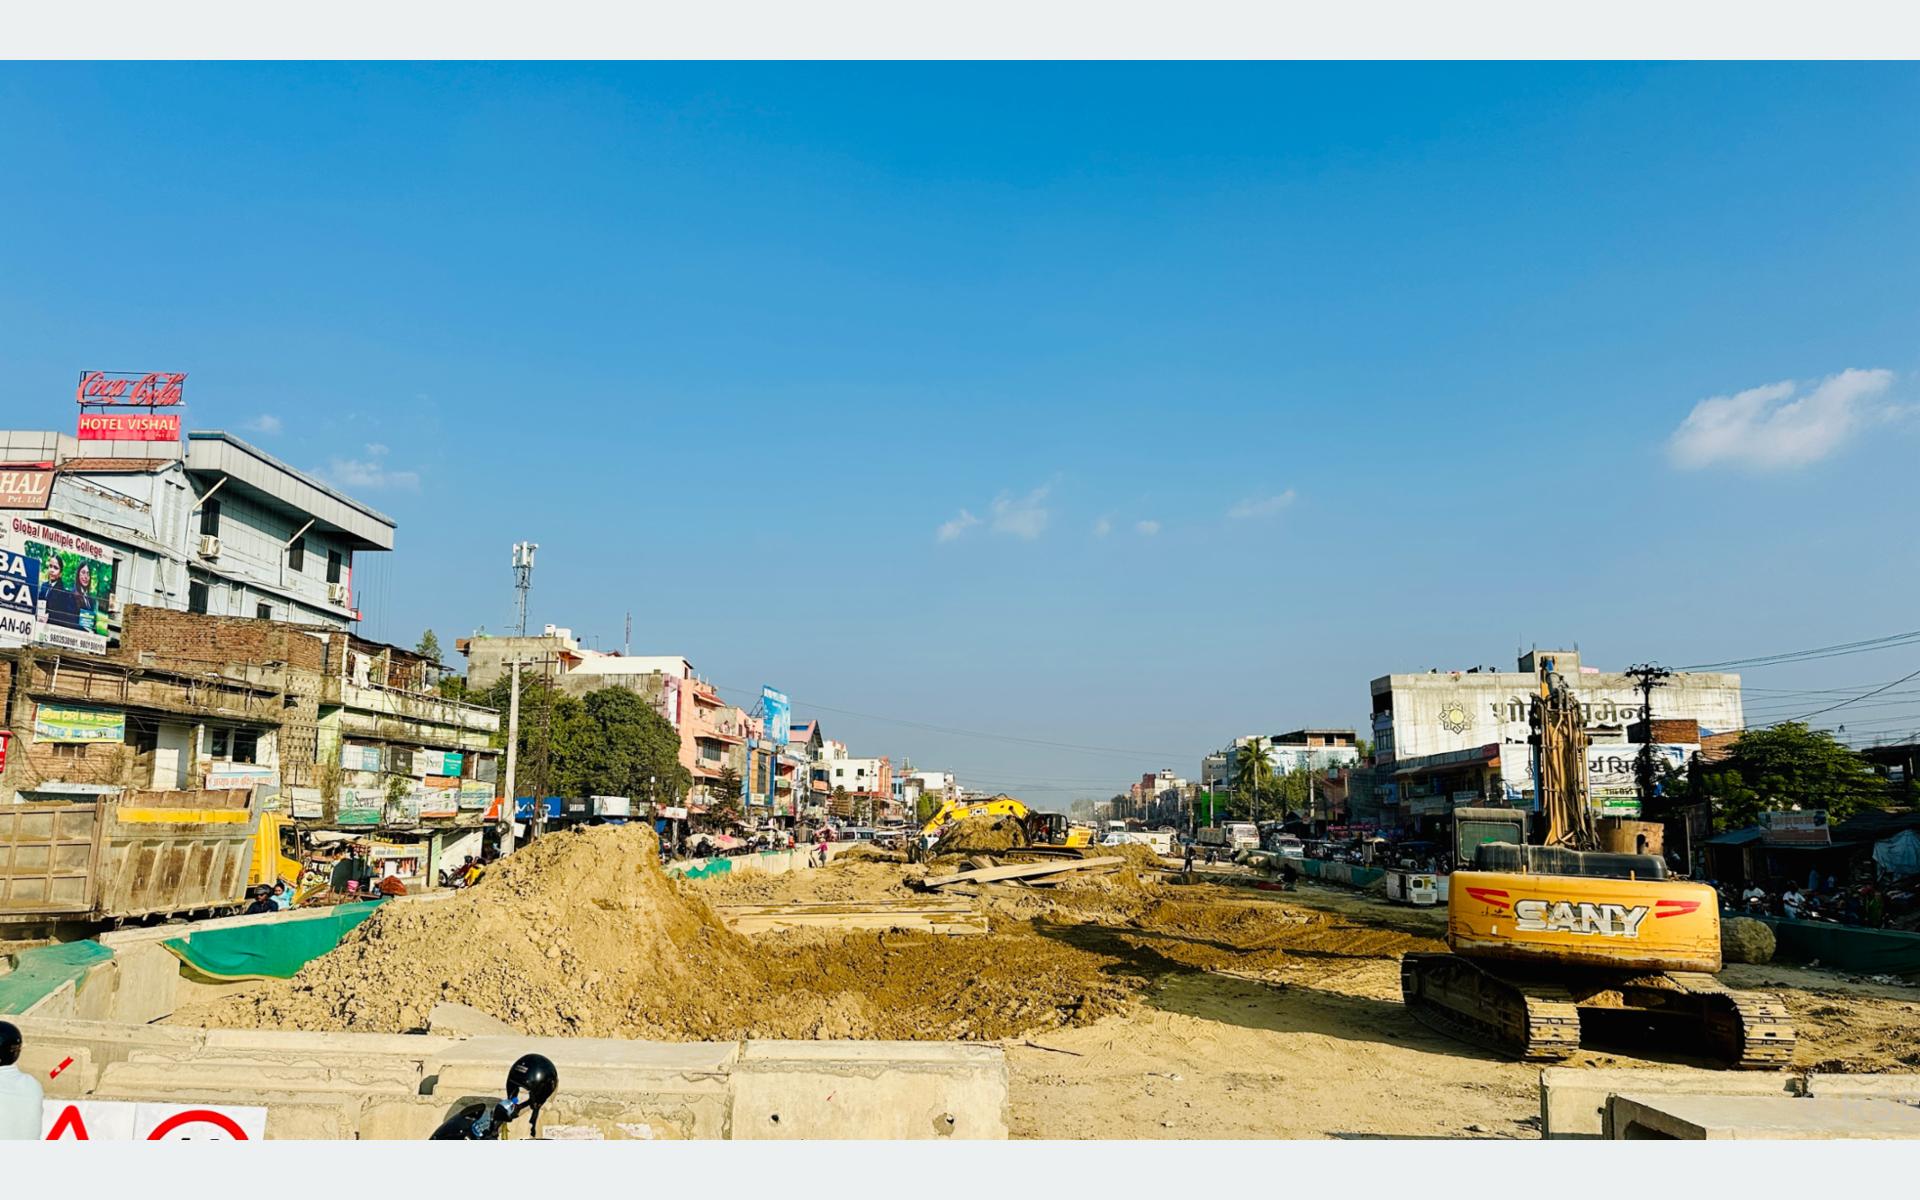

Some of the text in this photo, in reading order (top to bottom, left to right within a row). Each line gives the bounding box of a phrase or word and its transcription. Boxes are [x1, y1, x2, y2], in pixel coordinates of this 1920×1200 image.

[80, 418, 177, 431] HOTEL VISHAL
[12, 518, 40, 539] Global
[42, 526, 74, 548] Multiple
[75, 537, 103, 558] College
[0, 579, 33, 607] CA
[1515, 900, 1649, 937] SANY
